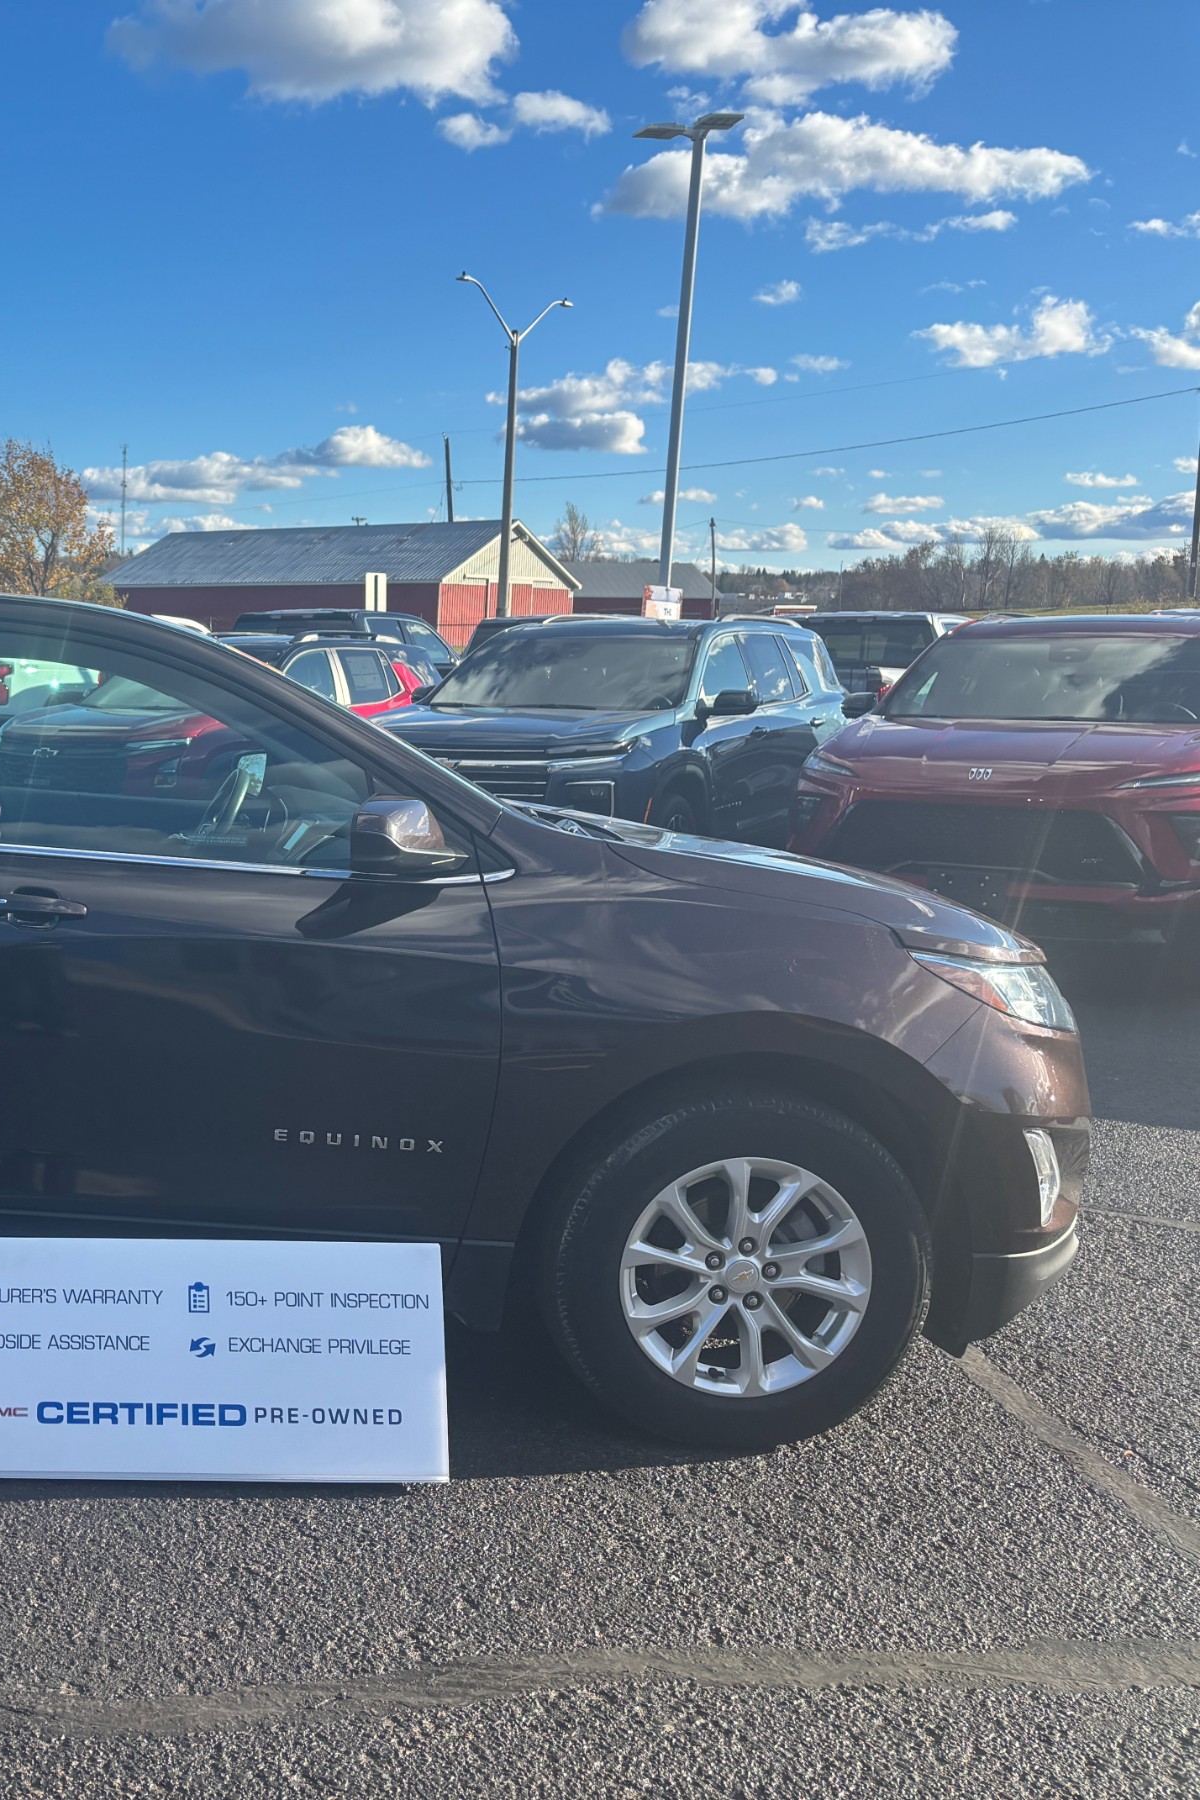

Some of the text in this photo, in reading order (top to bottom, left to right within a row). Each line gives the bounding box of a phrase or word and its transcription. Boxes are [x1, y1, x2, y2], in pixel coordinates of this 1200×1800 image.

[273, 1128, 444, 1153] EQUINOX
[62, 1289, 163, 1305] WARRANTY
[226, 1290, 430, 1310] 150+ POINT INSPECTION
[47, 1334, 150, 1352] ASSISTANCE
[228, 1336, 411, 1356] EXCHANGE PRIVILEGE
[37, 1401, 246, 1426] CERTIFIED
[255, 1407, 403, 1426] PRE-OWNED
